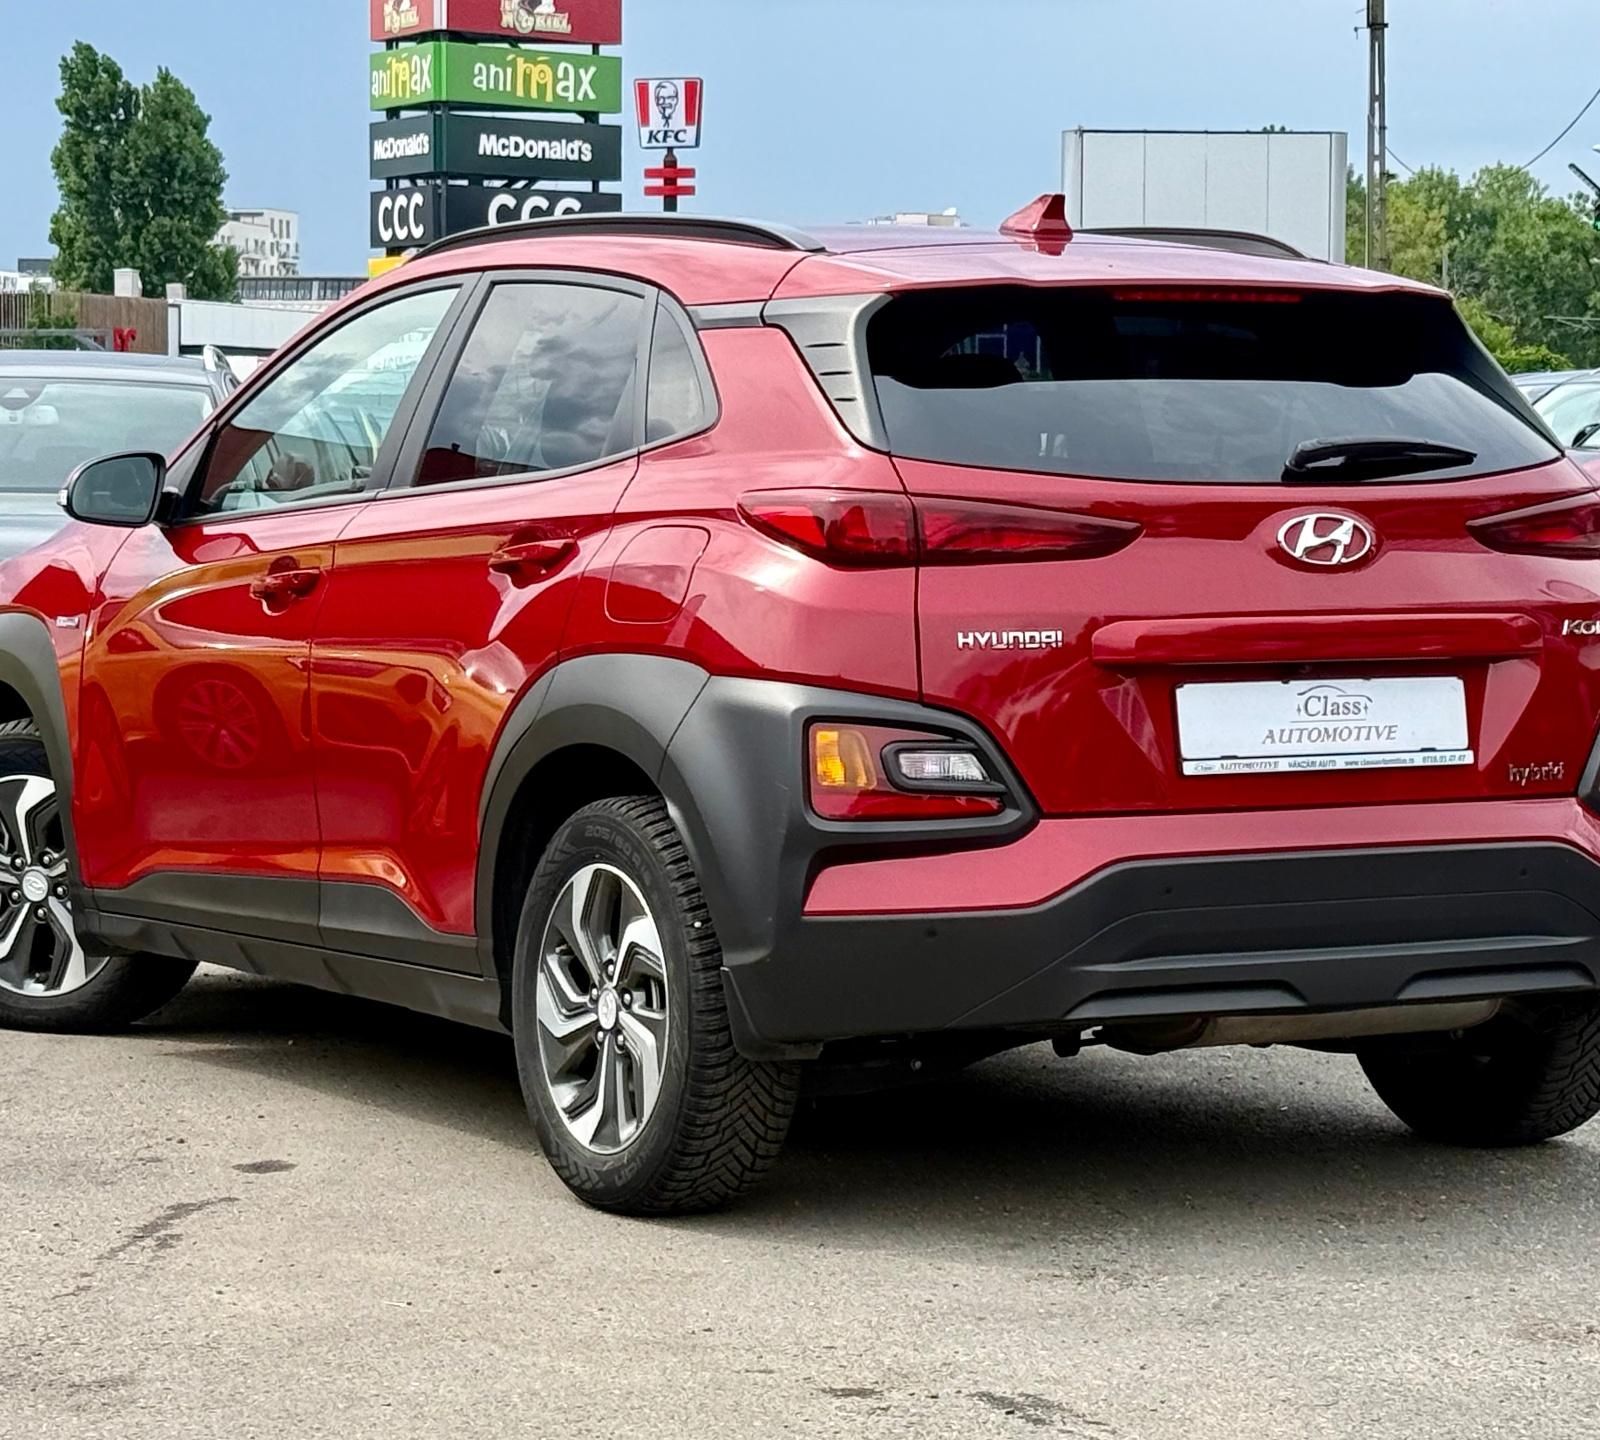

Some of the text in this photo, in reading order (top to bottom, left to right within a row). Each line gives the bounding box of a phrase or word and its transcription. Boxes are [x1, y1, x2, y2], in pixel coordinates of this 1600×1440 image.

[372, 53, 432, 99] animax
[473, 54, 597, 103] animax
[373, 133, 429, 160] McDonald's
[478, 133, 592, 162] McDonald's
[647, 129, 687, 144] KFC
[378, 192, 425, 241] CCC
[957, 630, 1063, 649] HYUNDAI
[1303, 695, 1362, 717] Class
[1262, 725, 1398, 745] AUTOMOTIVE
[1508, 761, 1565, 787] hybrid
